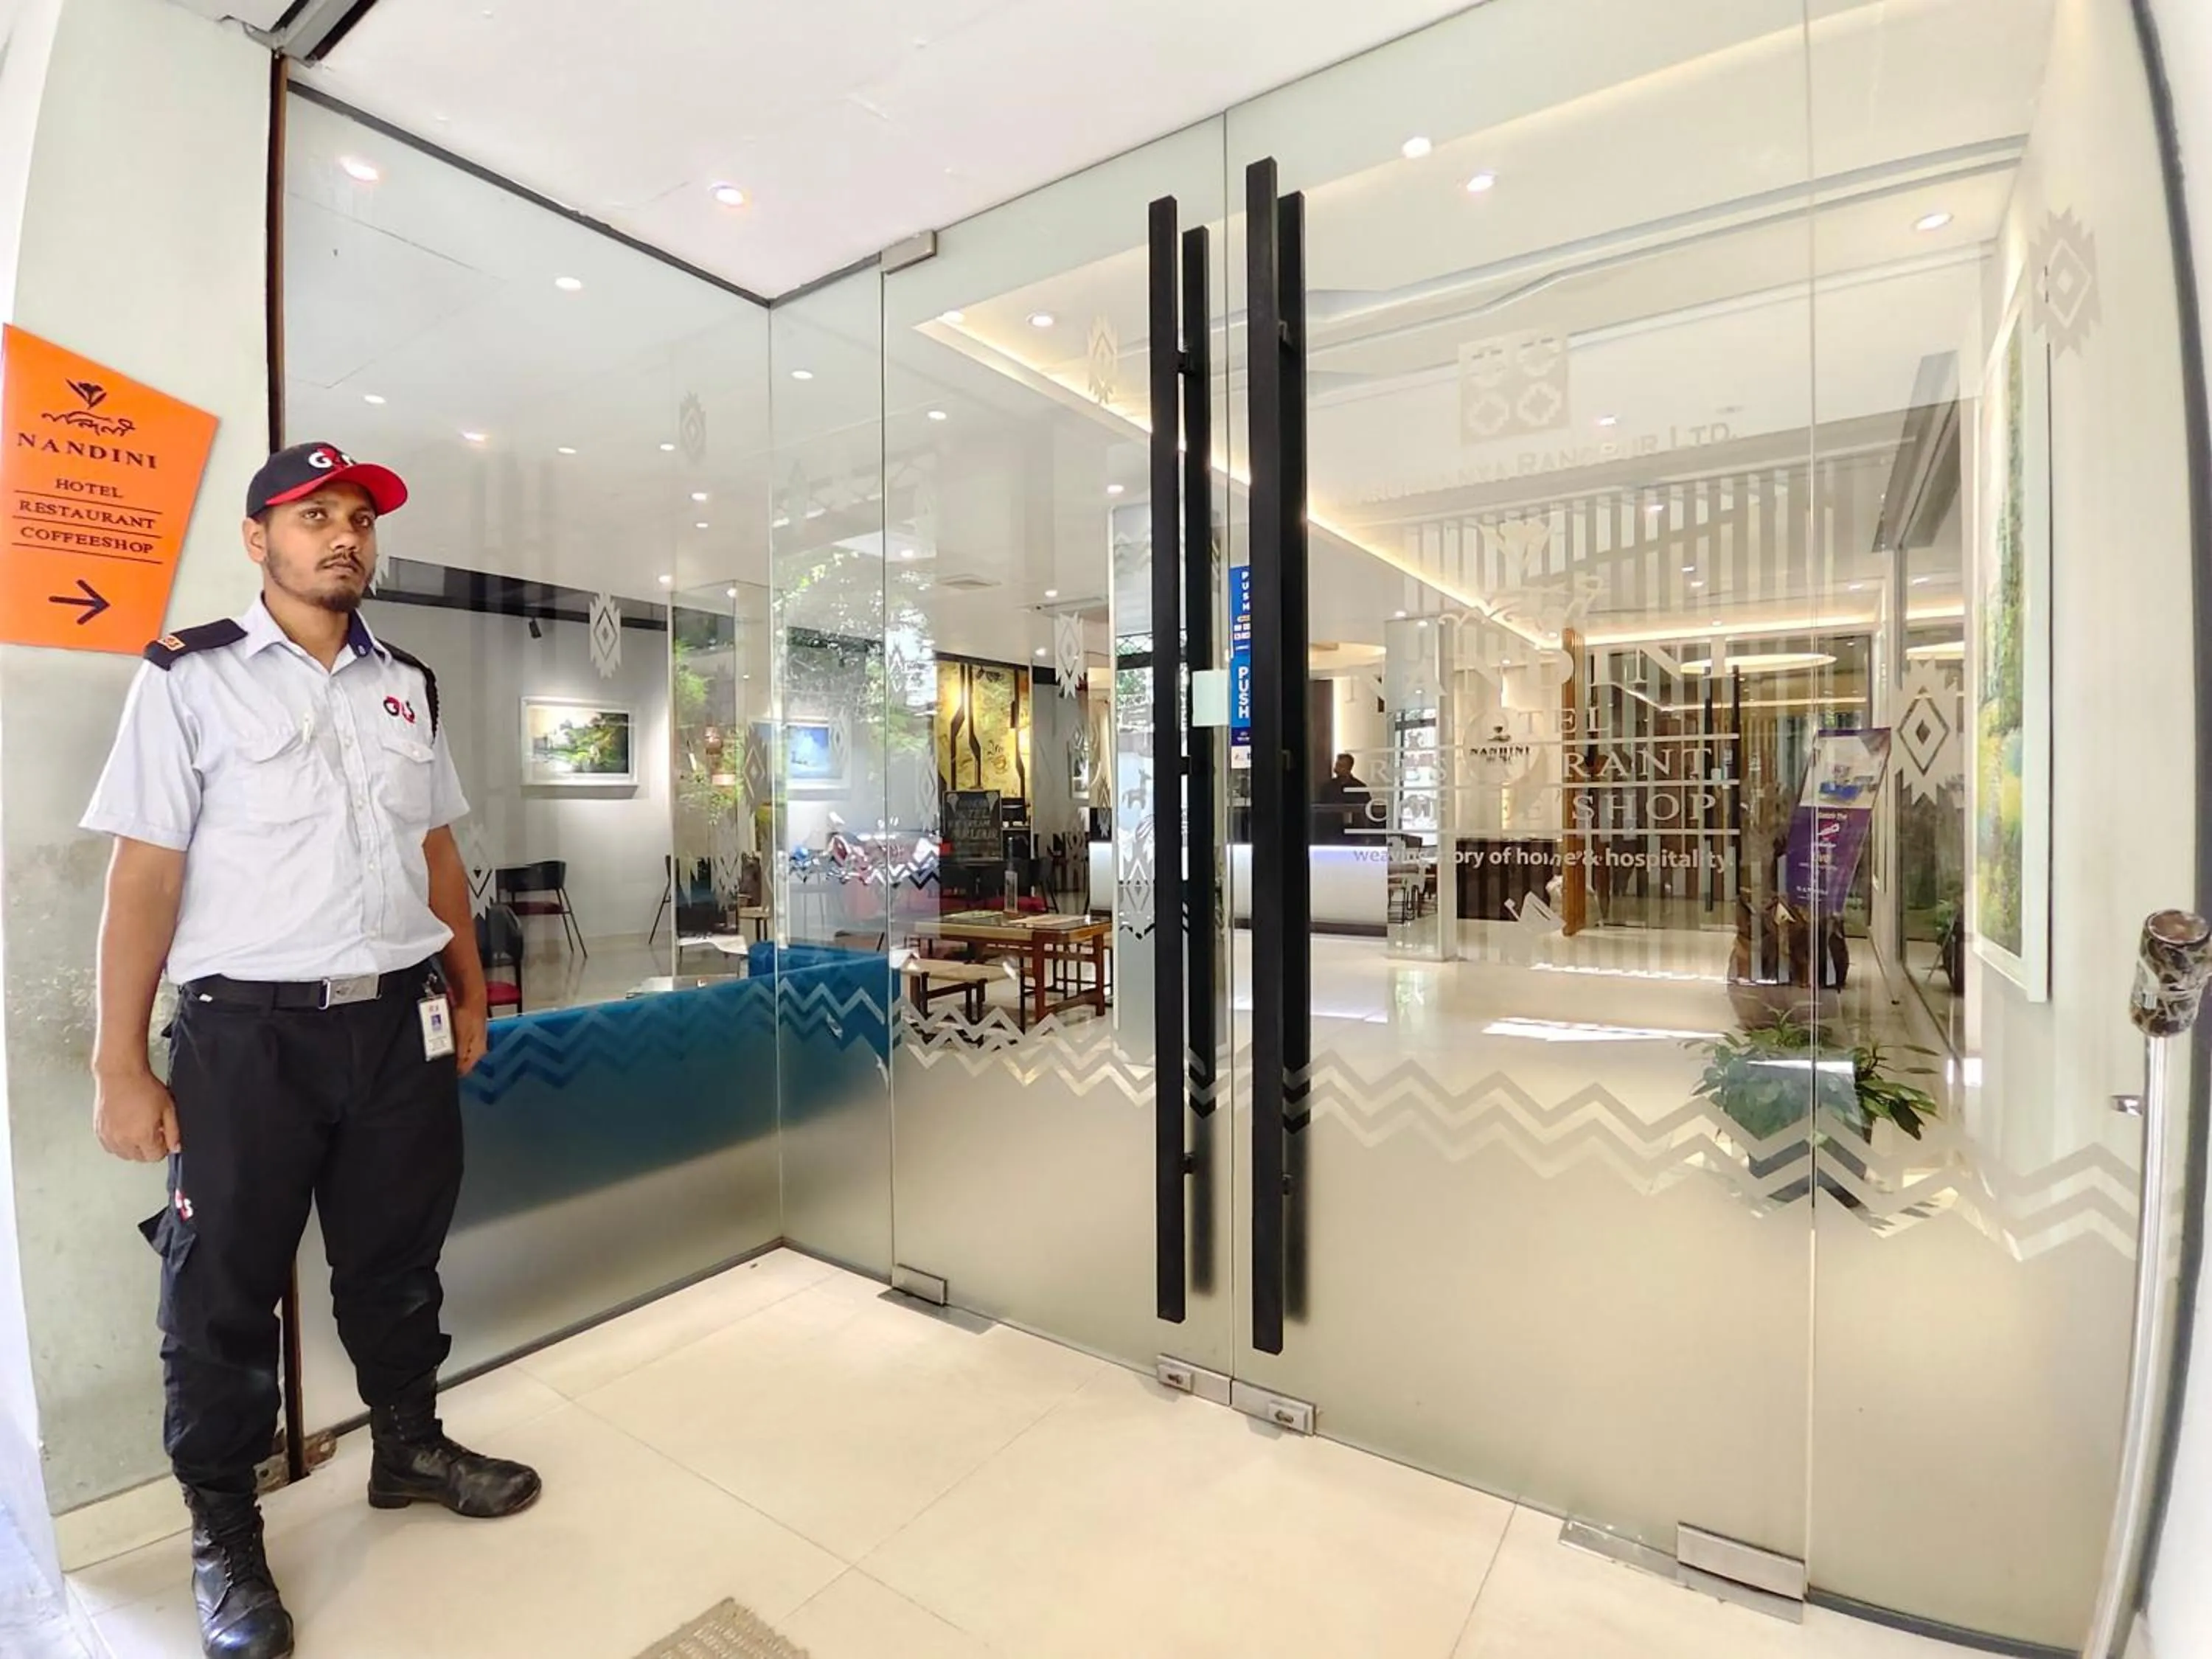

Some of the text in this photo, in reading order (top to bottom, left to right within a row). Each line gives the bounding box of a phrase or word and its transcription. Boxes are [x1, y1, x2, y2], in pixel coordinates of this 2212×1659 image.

[18, 432, 157, 469] NANDINI
[56, 478, 124, 498] HOTEL
[19, 499, 156, 529] RESTAURANT
[21, 526, 153, 553] COFFEESHOP
[1241, 571, 1251, 611] PUSH
[1238, 666, 1251, 719] PUSH
[1489, 846, 1512, 865] of
[1605, 846, 1725, 874] hospitalty
